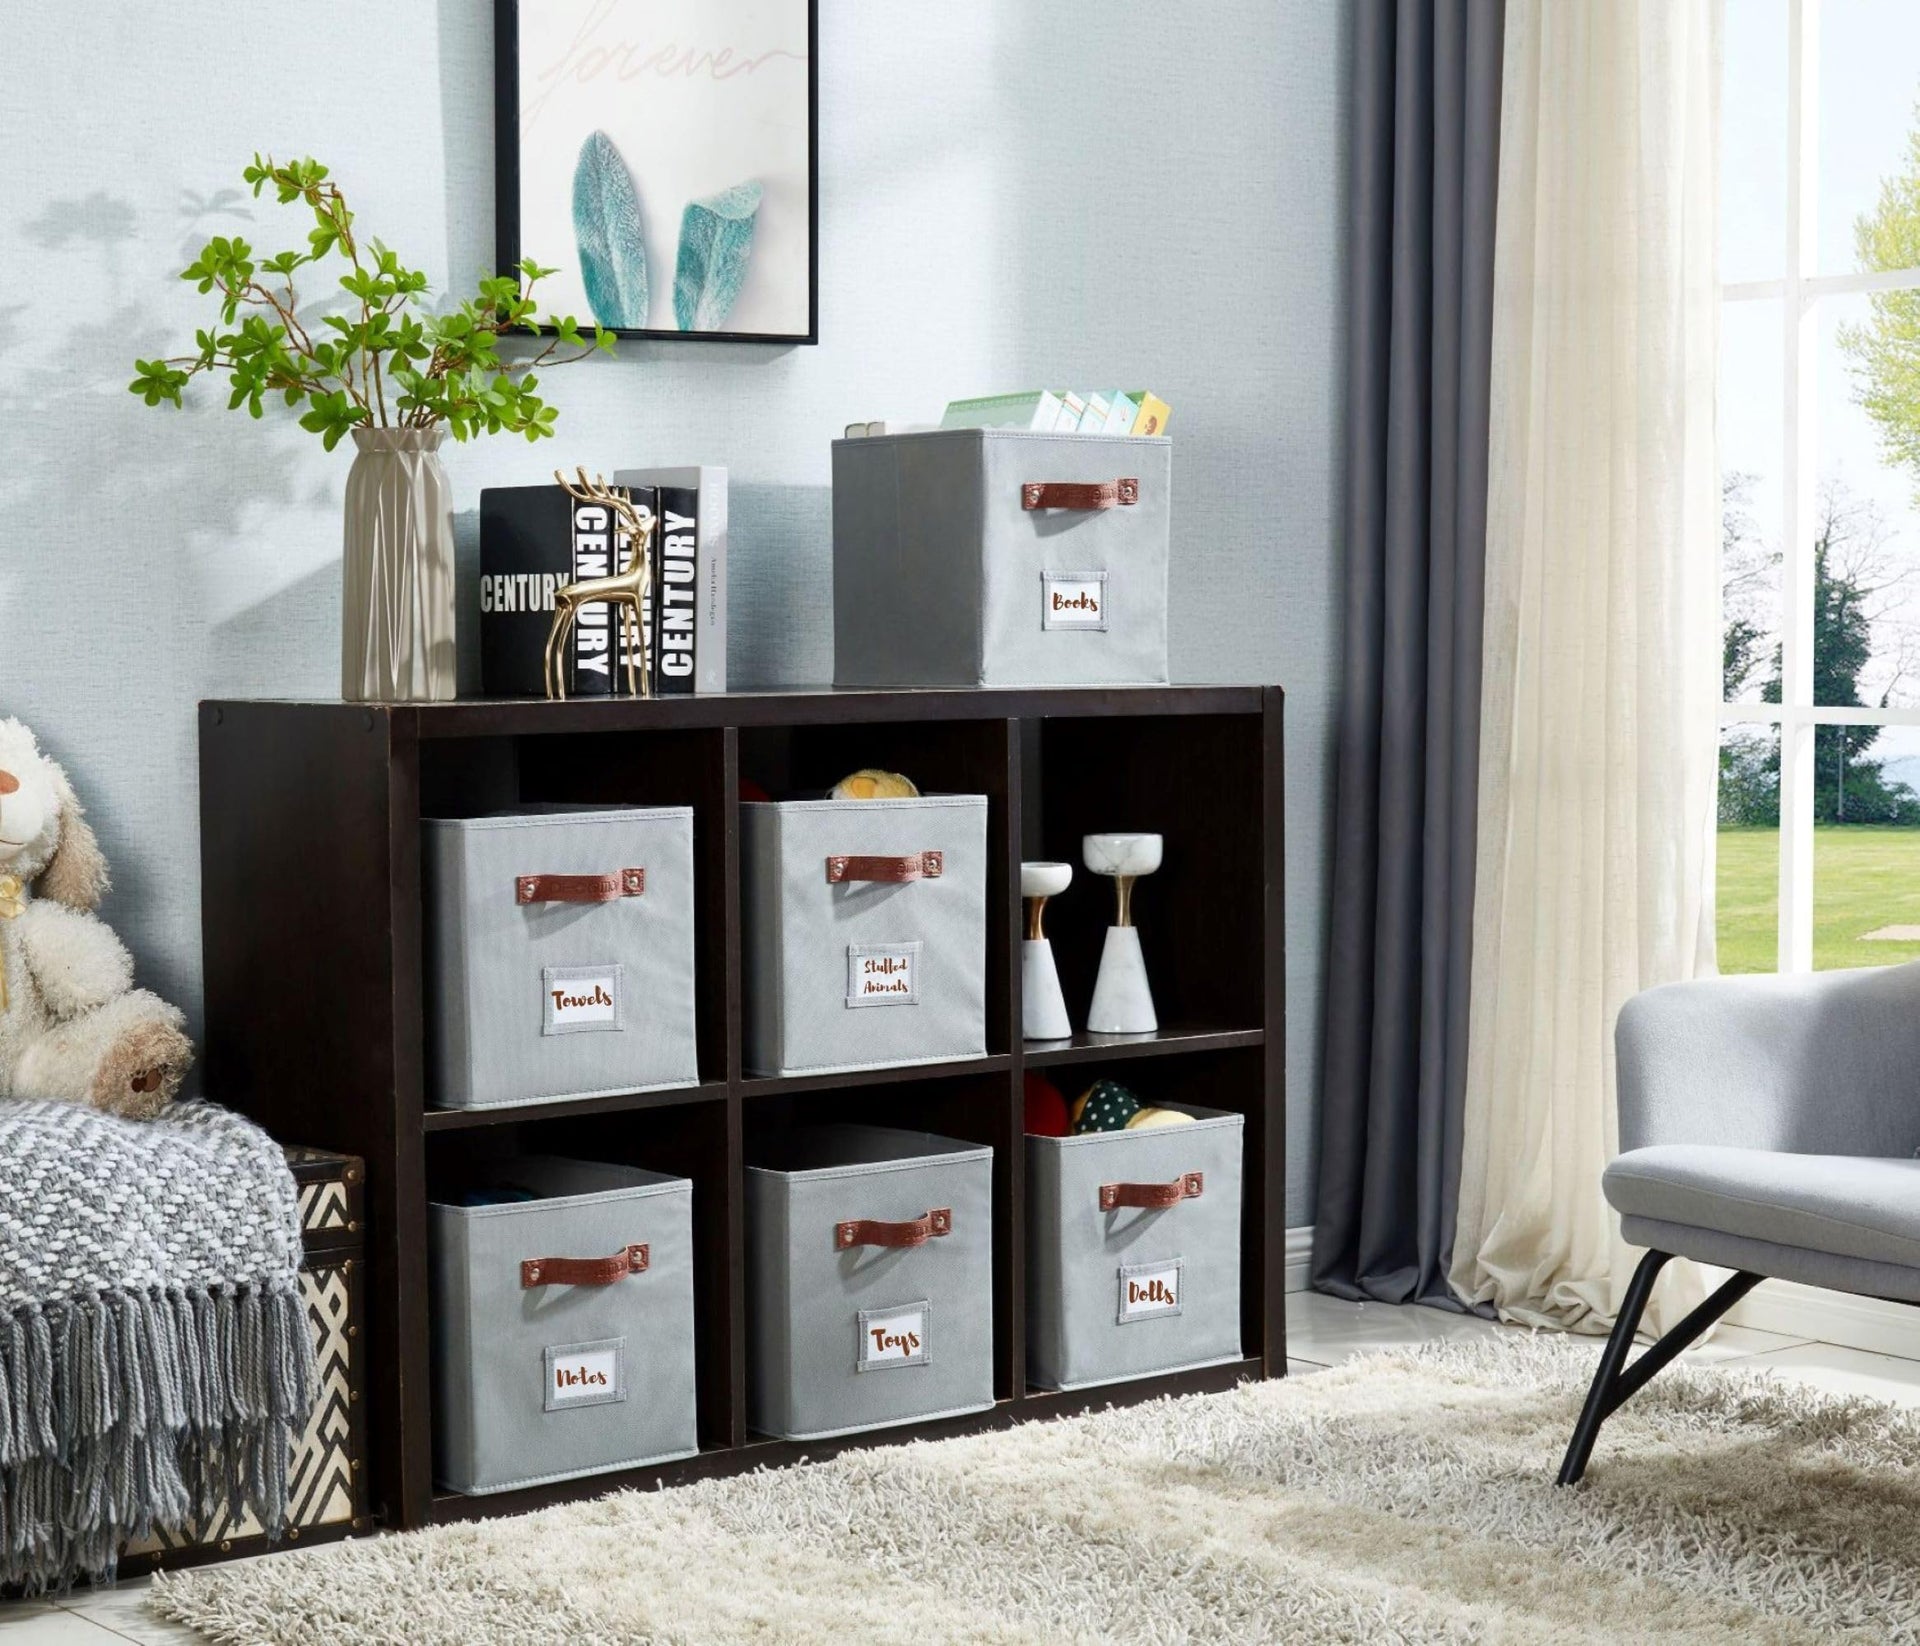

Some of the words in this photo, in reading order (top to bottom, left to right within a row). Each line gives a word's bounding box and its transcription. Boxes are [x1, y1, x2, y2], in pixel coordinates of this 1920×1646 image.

[575, 506, 609, 675] CENURY
[661, 510, 696, 677] CENTURY
[1053, 591, 1100, 612] Books
[864, 957, 908, 974] Stuffed
[551, 985, 613, 1010] Towels
[863, 979, 908, 994] Animals
[1129, 1280, 1176, 1305] Dolls
[870, 1328, 920, 1356] Toys
[556, 1366, 607, 1388] Notes
